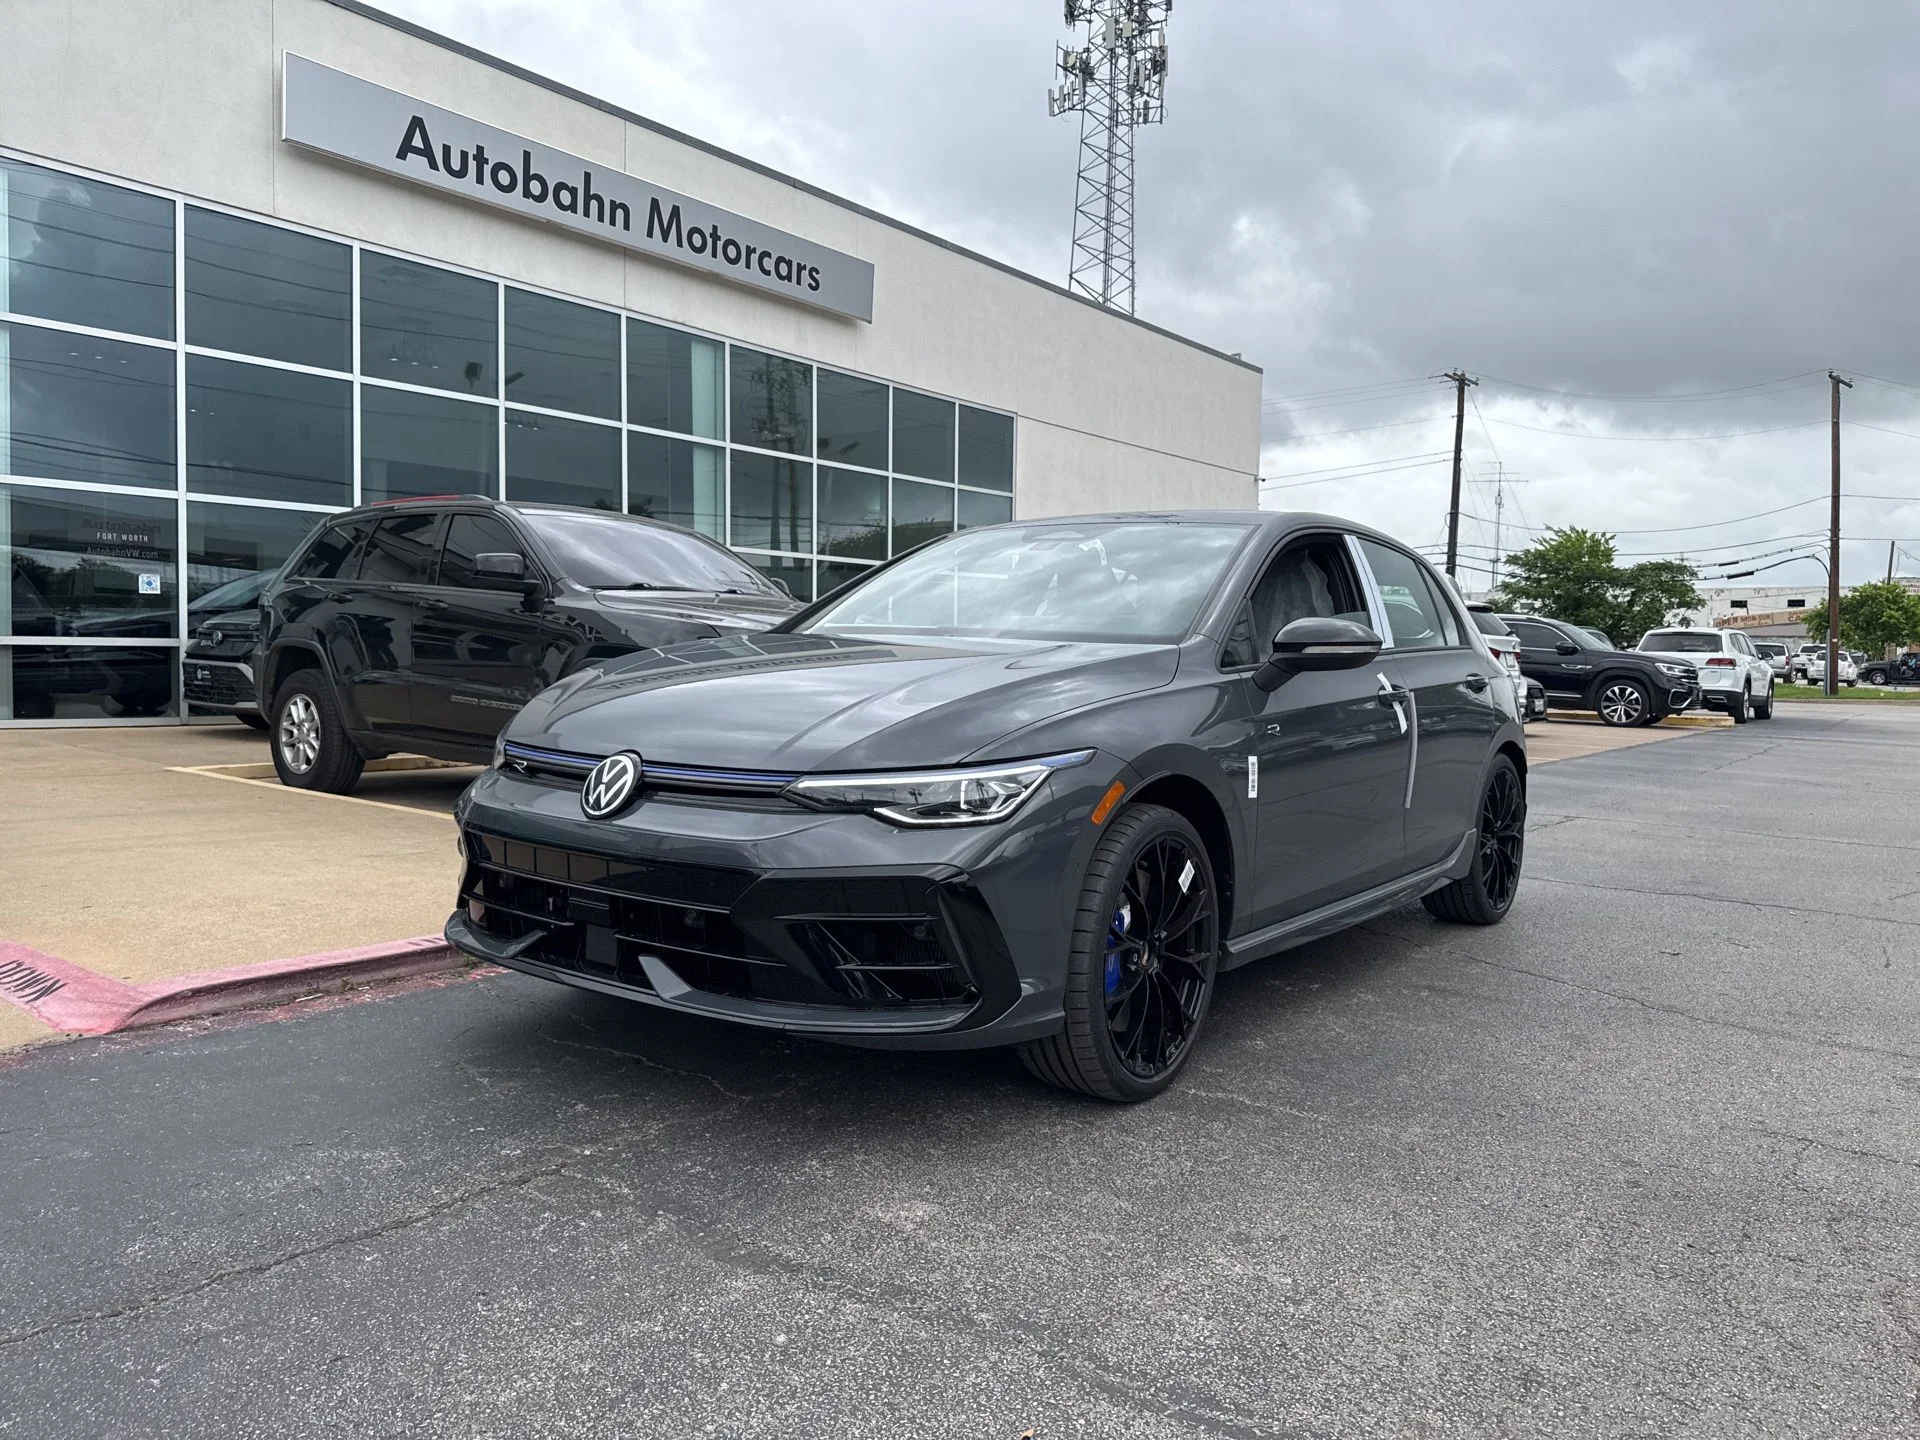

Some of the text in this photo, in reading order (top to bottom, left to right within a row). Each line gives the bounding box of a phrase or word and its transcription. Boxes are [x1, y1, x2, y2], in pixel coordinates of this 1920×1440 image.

[395, 115, 822, 292] Autobahn Motorcars
[96, 532, 149, 543] FORT WORTH
[86, 547, 159, 559] AutobahnVW.com
[1715, 616, 1738, 628] OPEN
